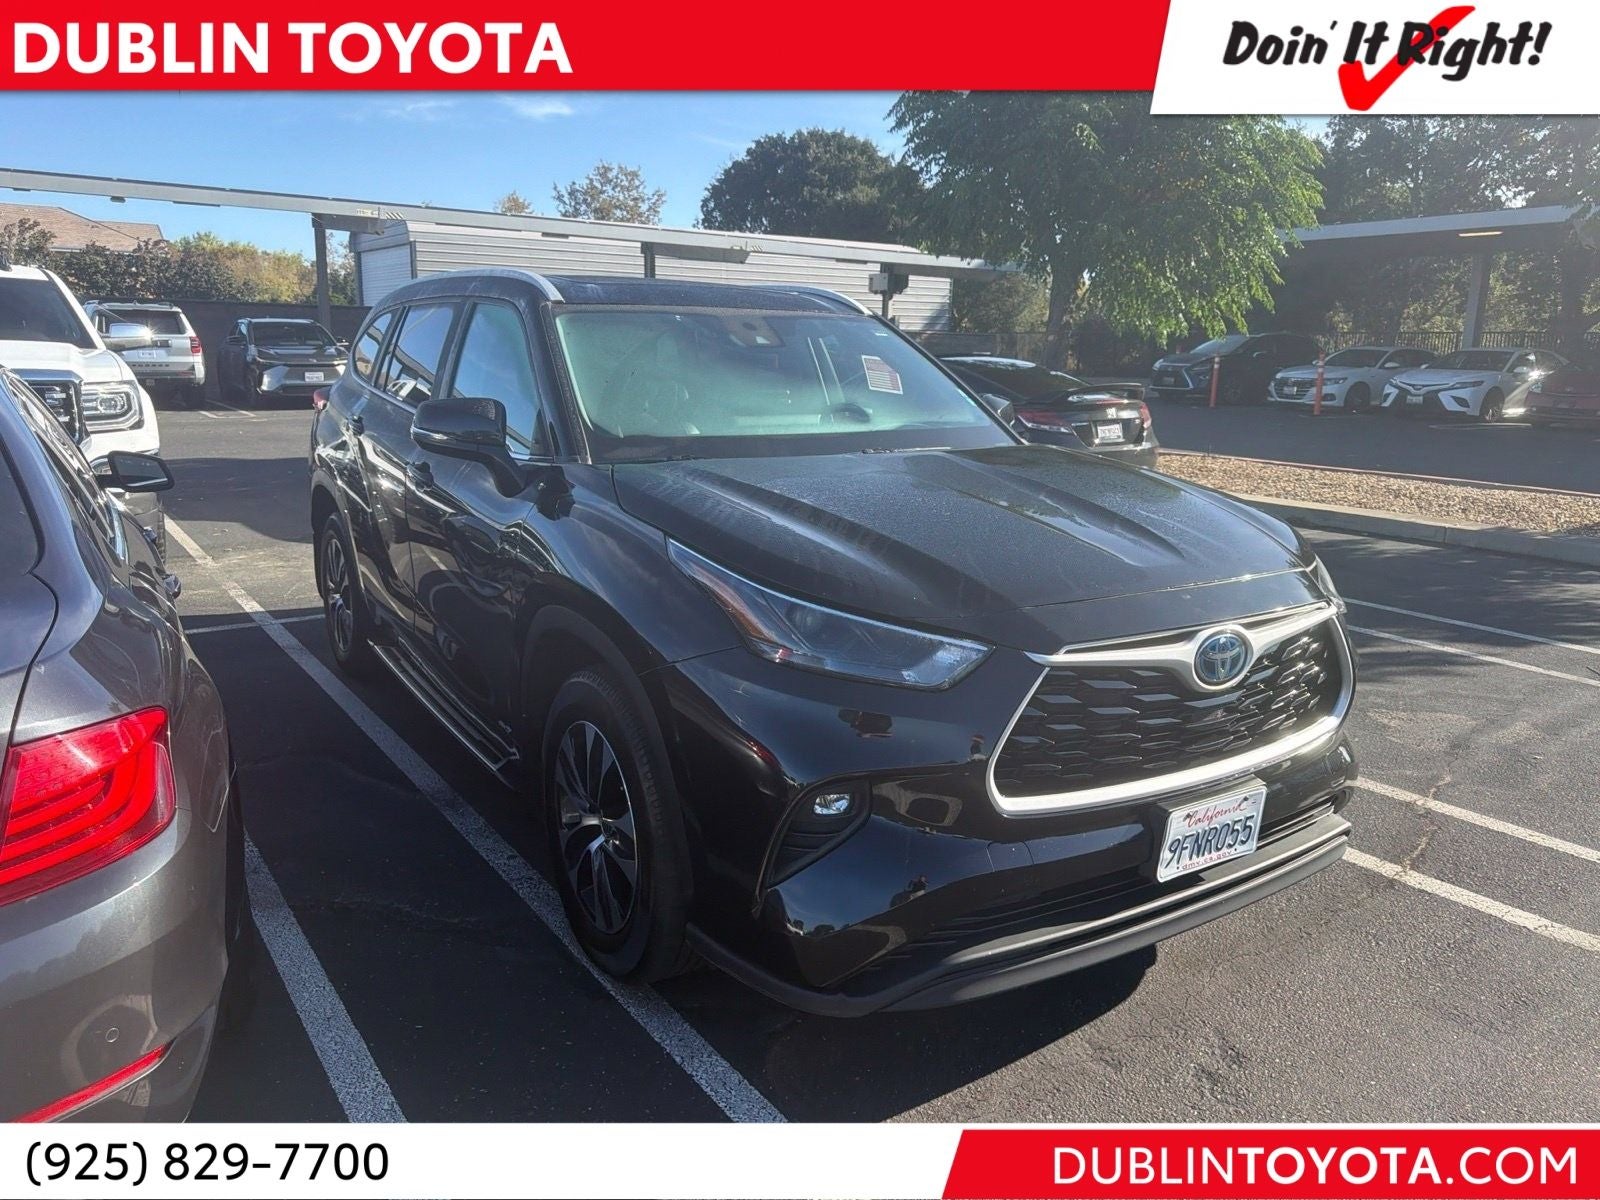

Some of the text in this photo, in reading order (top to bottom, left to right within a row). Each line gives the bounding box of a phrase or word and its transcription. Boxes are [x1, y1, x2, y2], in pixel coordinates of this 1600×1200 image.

[1187, 799, 1248, 828] California
[1165, 815, 1255, 869] 9FNR055
[1181, 850, 1232, 870] dmv.ca.gov
